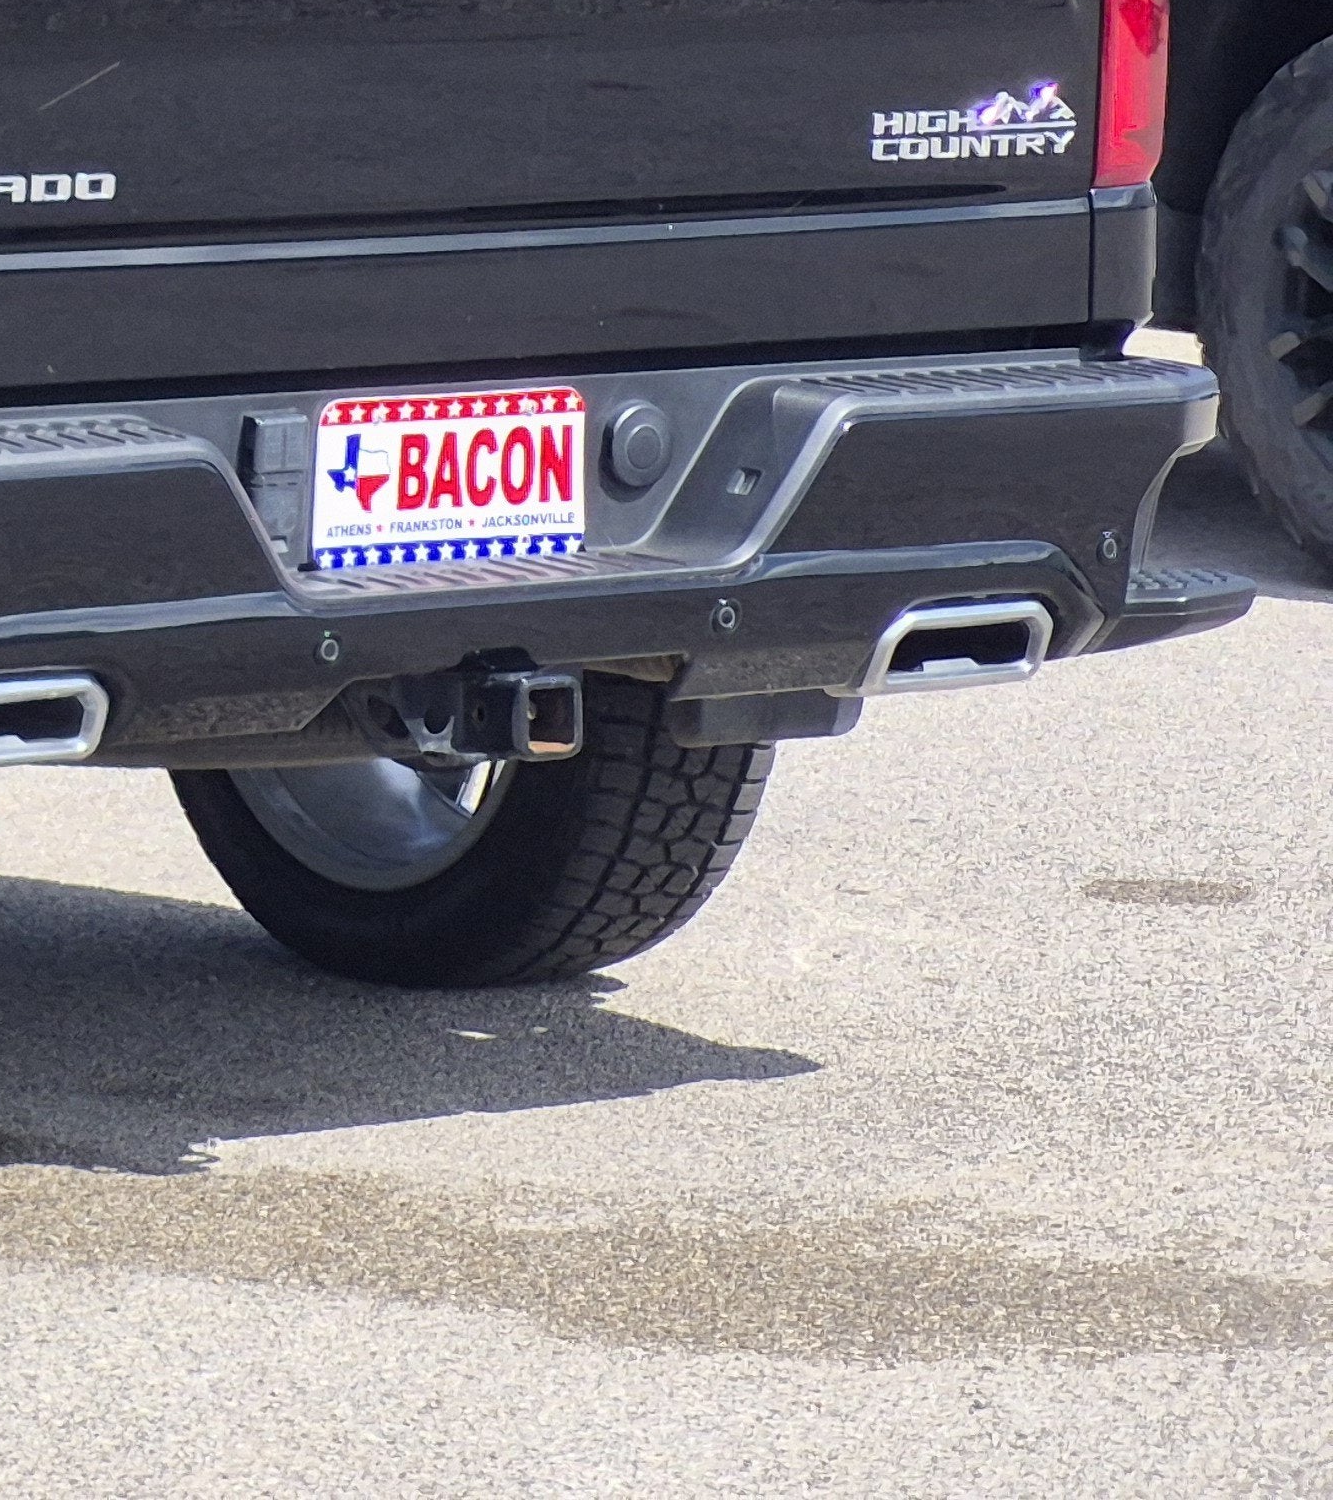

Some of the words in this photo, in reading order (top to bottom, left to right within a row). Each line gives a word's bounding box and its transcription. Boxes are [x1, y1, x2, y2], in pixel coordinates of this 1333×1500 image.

[872, 109, 976, 135] HIGH
[871, 130, 1075, 161] COUNTRY
[396, 425, 573, 511] BACON
[327, 524, 372, 538] ATHENS
[389, 518, 463, 534] FRANKSTON
[482, 512, 575, 528] JACKSONVILLE
